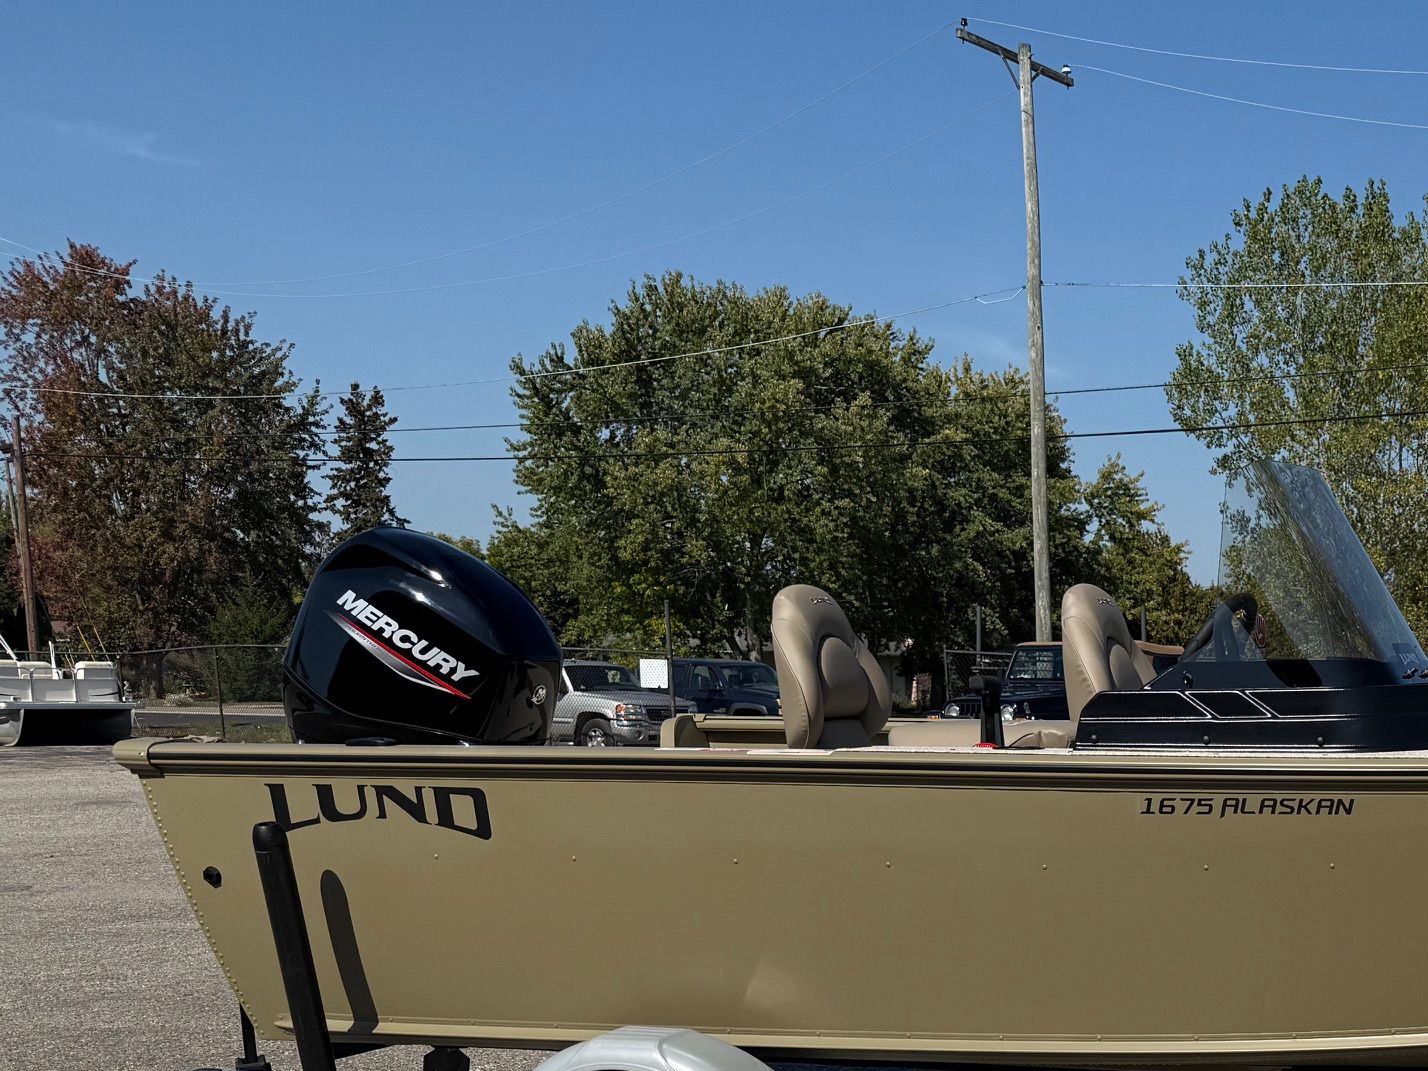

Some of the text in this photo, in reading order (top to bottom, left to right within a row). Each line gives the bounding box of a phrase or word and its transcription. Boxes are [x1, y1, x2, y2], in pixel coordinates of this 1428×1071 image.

[336, 589, 480, 682] MERCURY
[264, 783, 492, 840] LUND
[1140, 797, 1355, 819] 1675 ALASKAN
